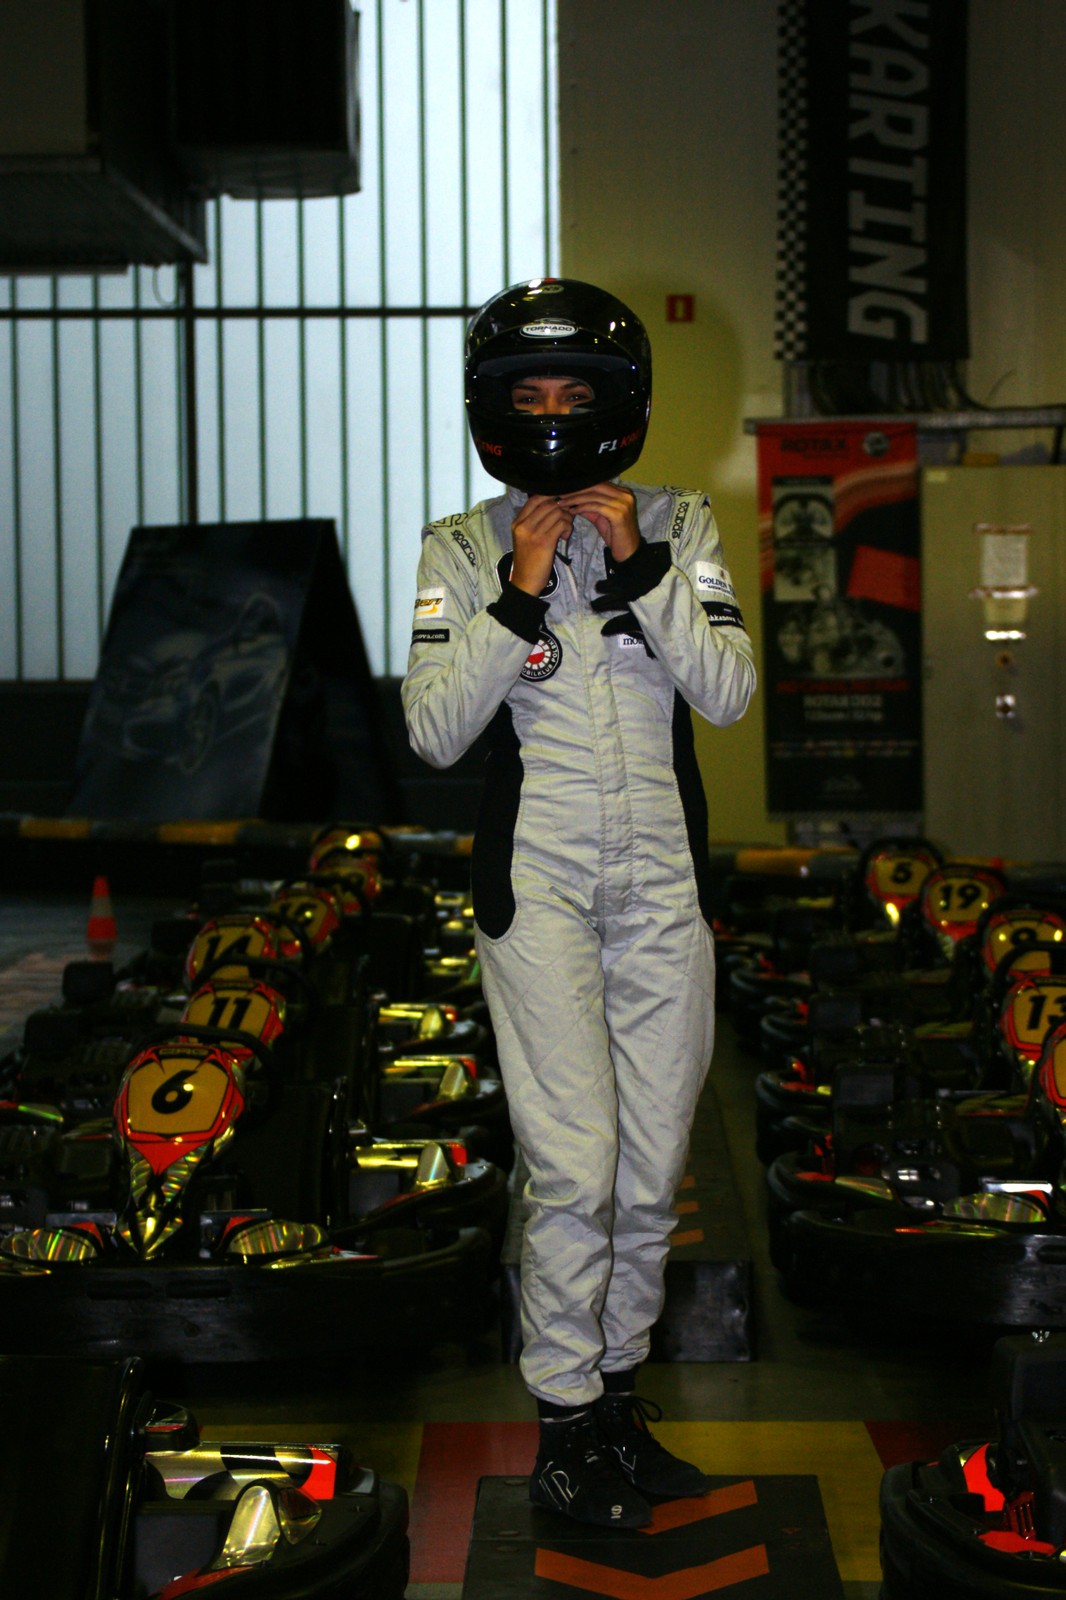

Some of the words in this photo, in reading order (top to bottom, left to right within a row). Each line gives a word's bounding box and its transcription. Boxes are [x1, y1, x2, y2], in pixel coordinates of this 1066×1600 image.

[847, 0, 931, 345] KARTING
[598, 438, 618, 454] F1
[672, 501, 691, 539] sparco
[450, 529, 477, 567] sparco
[940, 884, 981, 911] 19
[208, 999, 251, 1030] 11
[151, 1069, 198, 1114] 6
